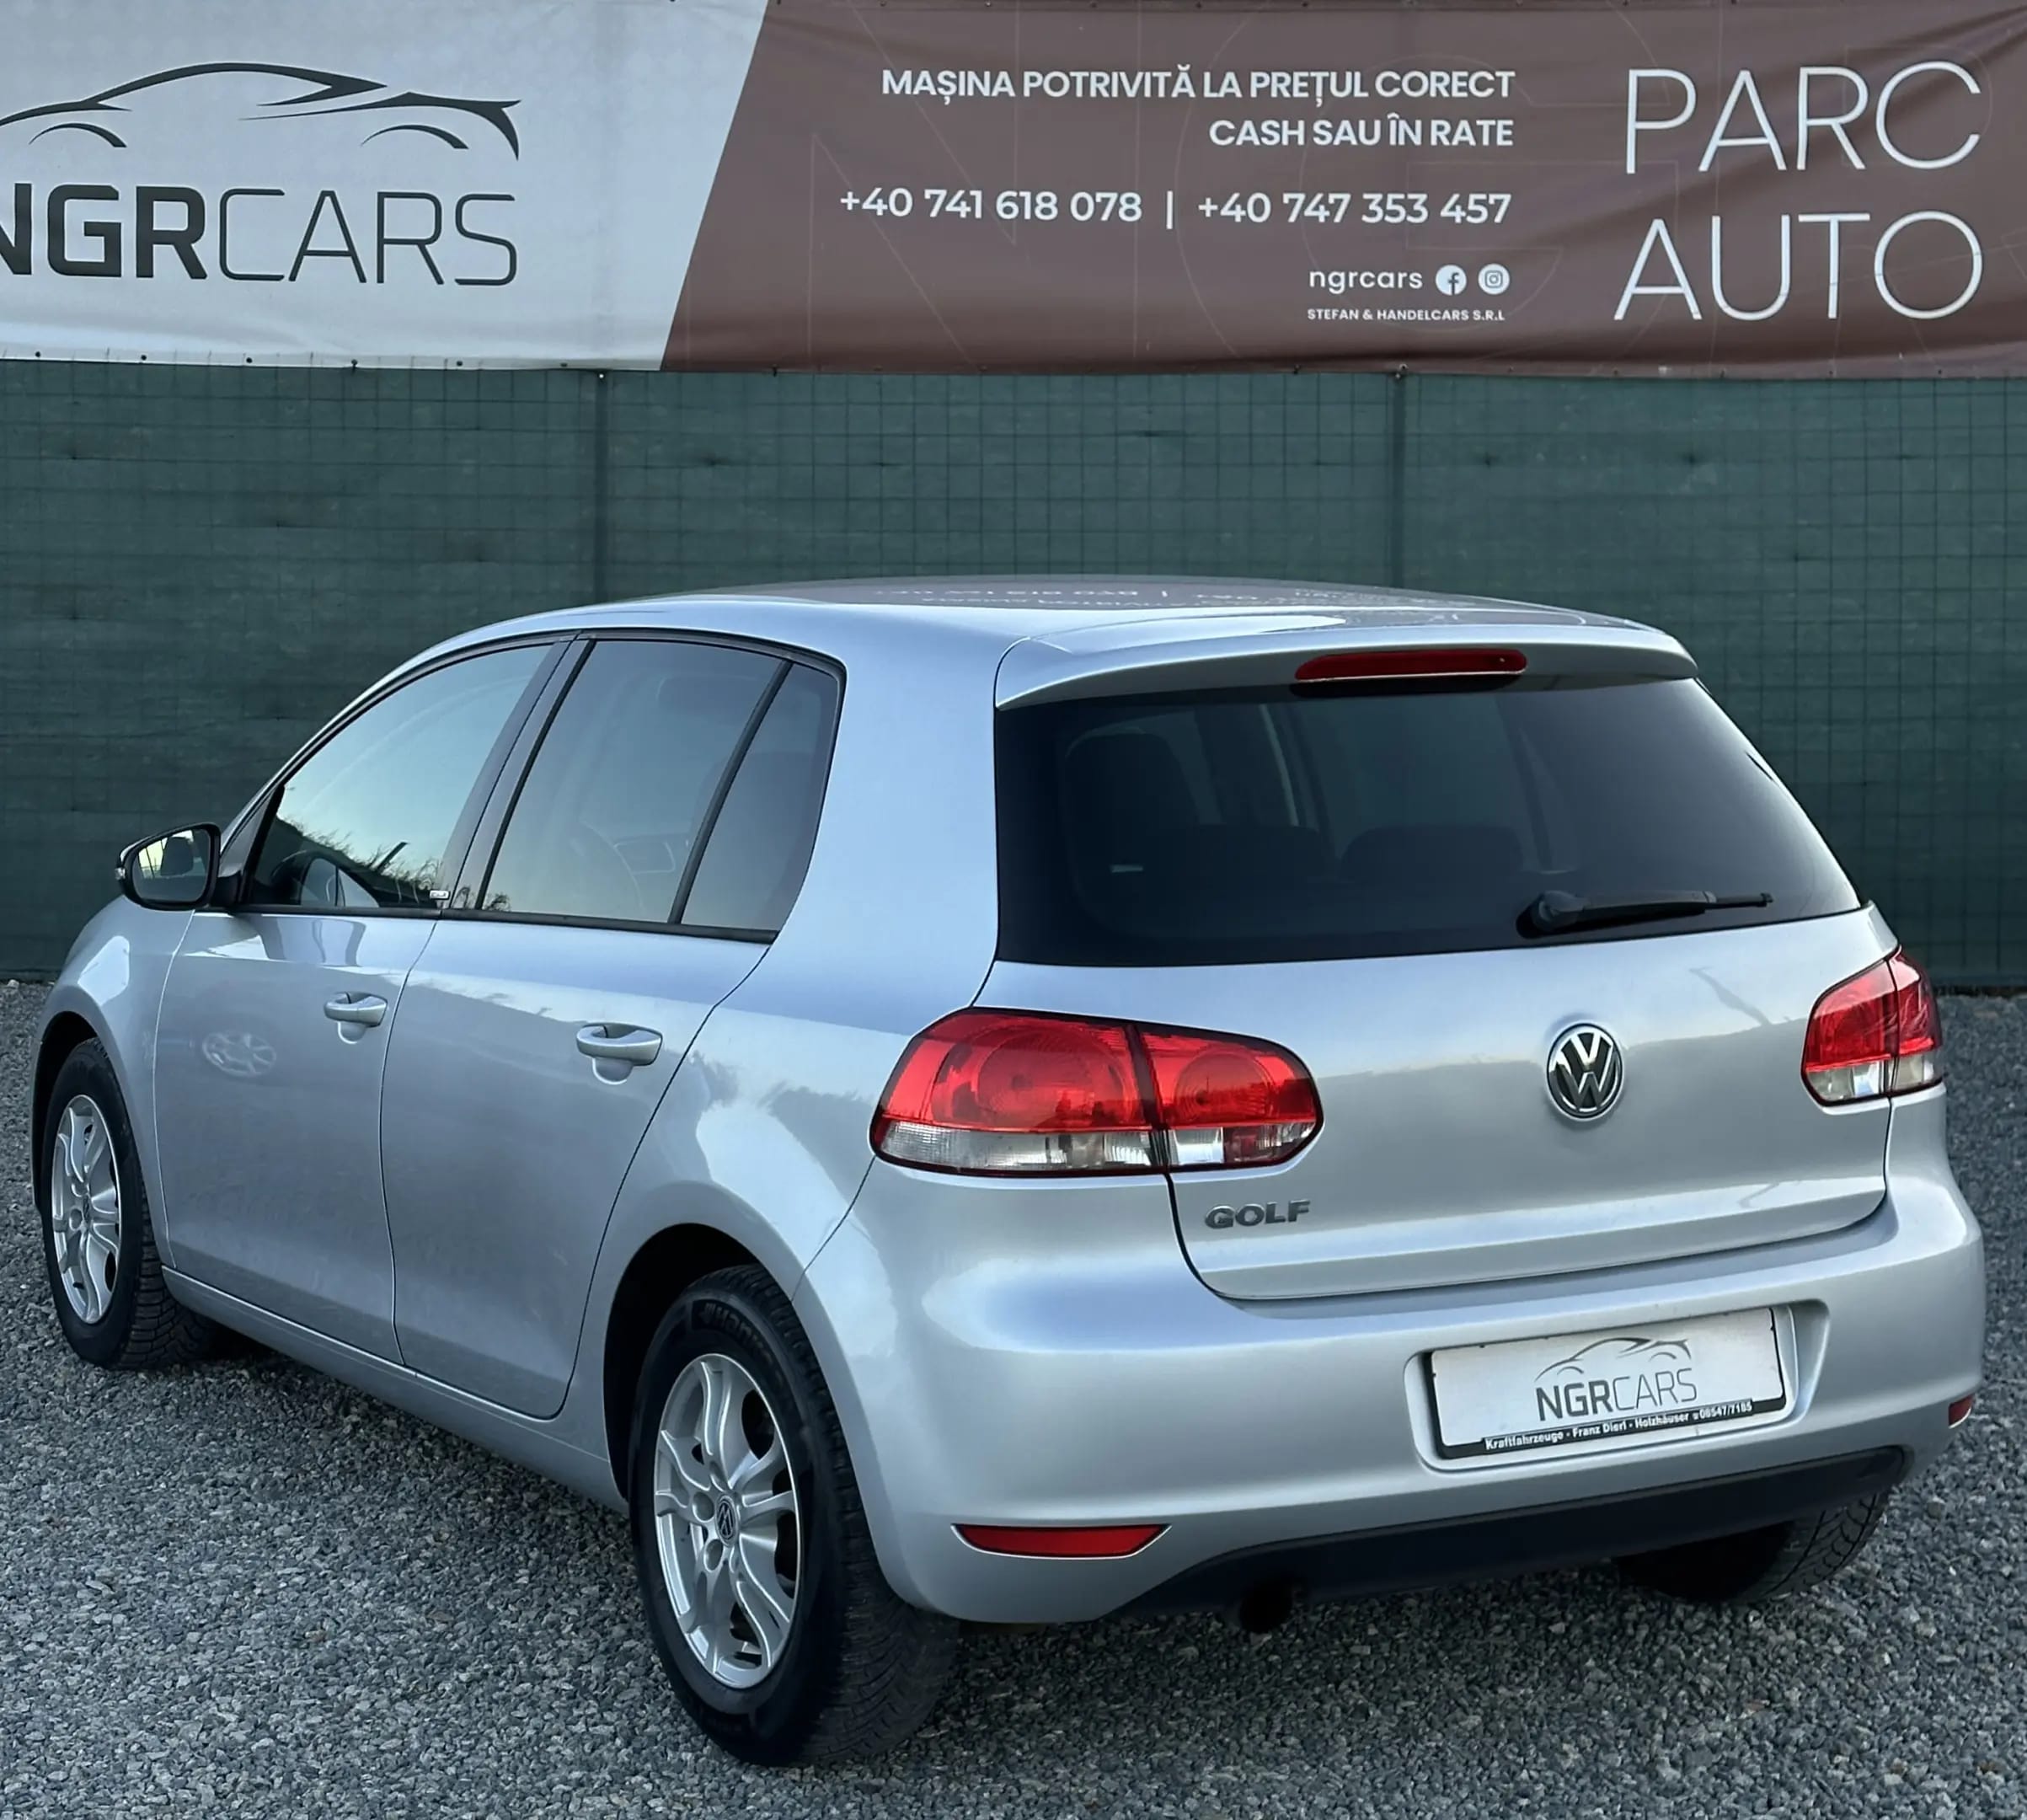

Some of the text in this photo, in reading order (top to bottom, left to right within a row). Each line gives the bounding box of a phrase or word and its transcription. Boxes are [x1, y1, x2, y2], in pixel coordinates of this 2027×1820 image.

[882, 64, 1516, 107] MAȘINA POTRIVITĂ LA PREȚUL CORECT
[1209, 113, 1514, 147] CASH SAU ÎN RATE
[1626, 62, 1982, 174] PARC
[840, 186, 913, 217] +40
[924, 189, 982, 219] 741
[996, 190, 1058, 221] 618
[1070, 191, 1142, 222] 078
[1198, 191, 1271, 223] +40
[1282, 192, 1351, 223] 747
[1361, 193, 1429, 223] 353
[1440, 193, 1511, 224] 457
[1309, 270, 1423, 295] ngrcars
[1613, 211, 1983, 321] AUTO
[1307, 308, 1359, 320] STEFAN
[1362, 308, 1373, 320] &
[1377, 308, 1469, 321] HANDELCARS
[1205, 1200, 1310, 1228] GOLF
[1535, 1368, 1697, 1421] NGRCARS
[1572, 1426, 1601, 1438] Franz
